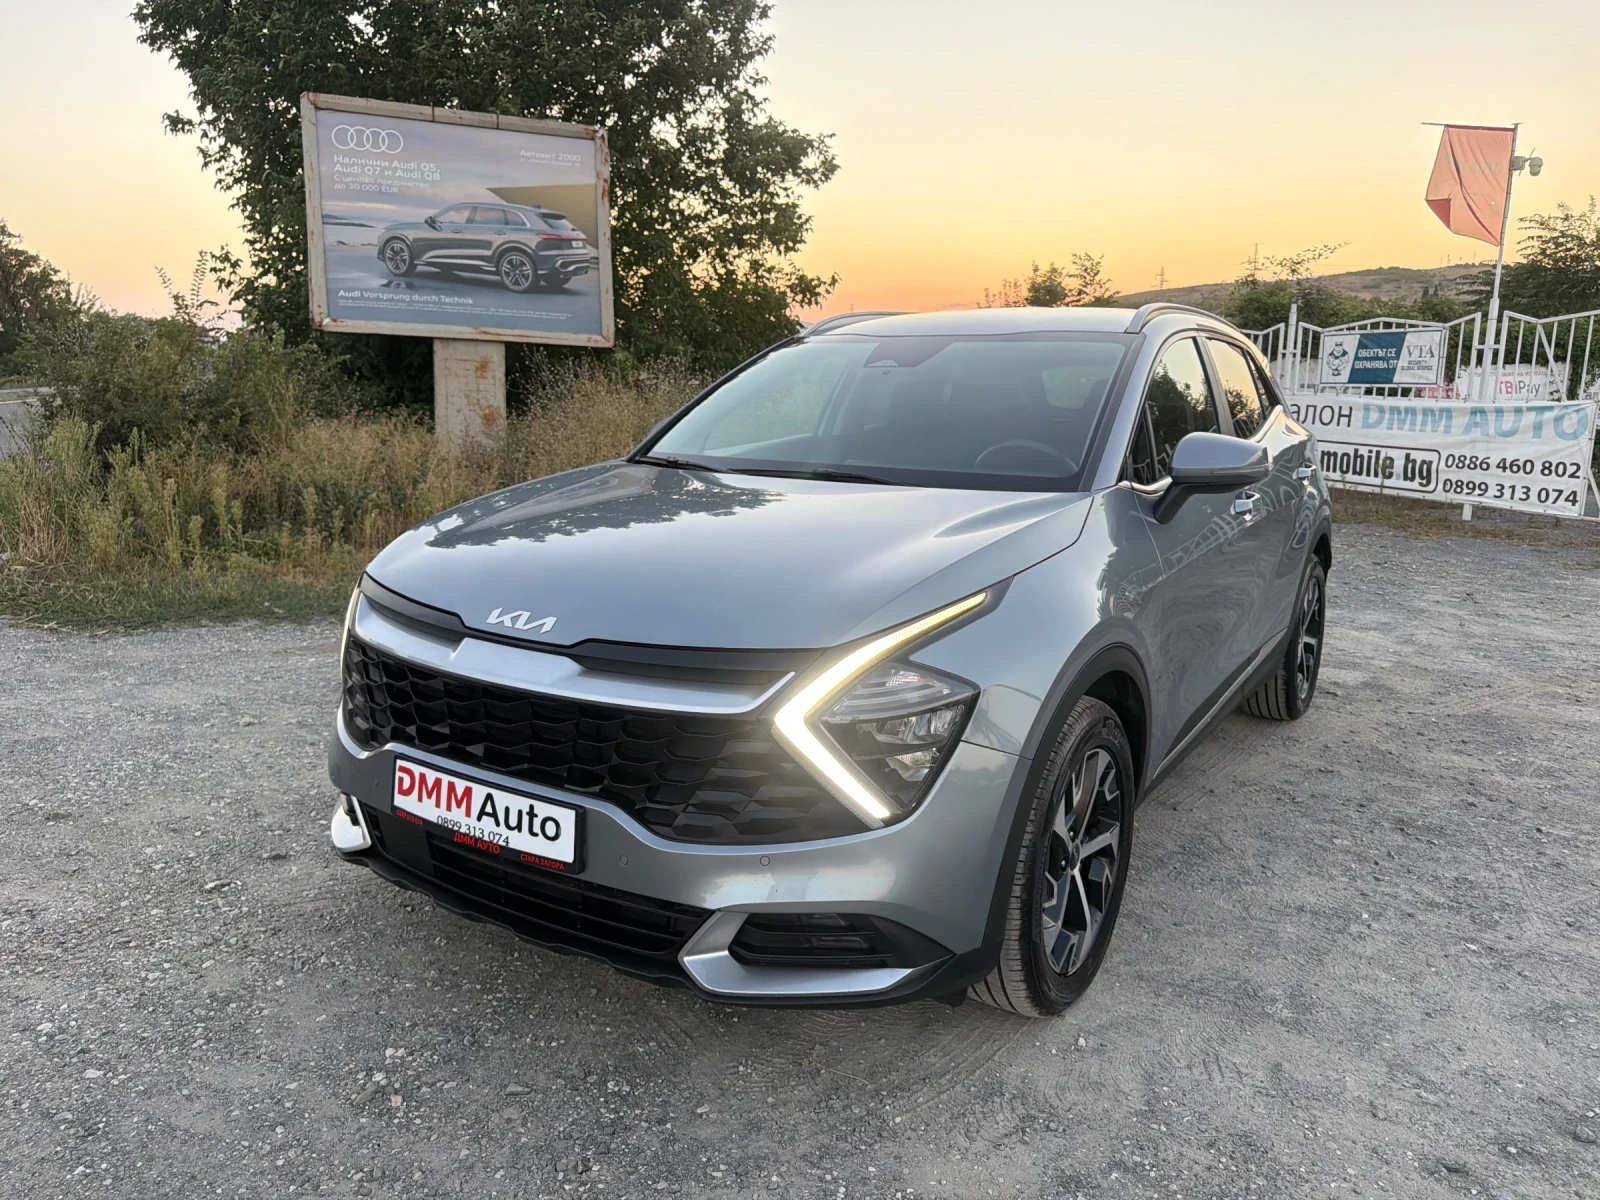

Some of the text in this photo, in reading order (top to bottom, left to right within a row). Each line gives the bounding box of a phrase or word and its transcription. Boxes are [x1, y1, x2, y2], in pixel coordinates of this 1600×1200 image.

[334, 154, 440, 172] Налични Audi Q5,
[558, 153, 580, 162] 2000
[334, 164, 361, 173] Audi
[364, 166, 380, 175] Q7
[396, 170, 420, 179] Audi
[424, 172, 440, 181] Q8
[362, 290, 410, 301] Vorsprung
[412, 294, 438, 303] durch
[441, 296, 474, 304] Technik
[1358, 348, 1397, 357] ОБЕКТЪТ СЕ
[1406, 344, 1435, 358] VTA
[1354, 360, 1398, 369] ОХРАНЯВА ОТ
[1290, 403, 1589, 441] алон DMM AUTO
[1320, 448, 1433, 488] mobile.bg
[1444, 454, 1581, 479] 0886 460 802
[1442, 478, 1578, 507] 0899 313 074
[486, 607, 558, 634] KIA
[436, 815, 510, 847] 0899 313 074
[454, 832, 500, 854] ДММ АУТО
[520, 854, 565, 870] СТАРА ЗАГОРА
